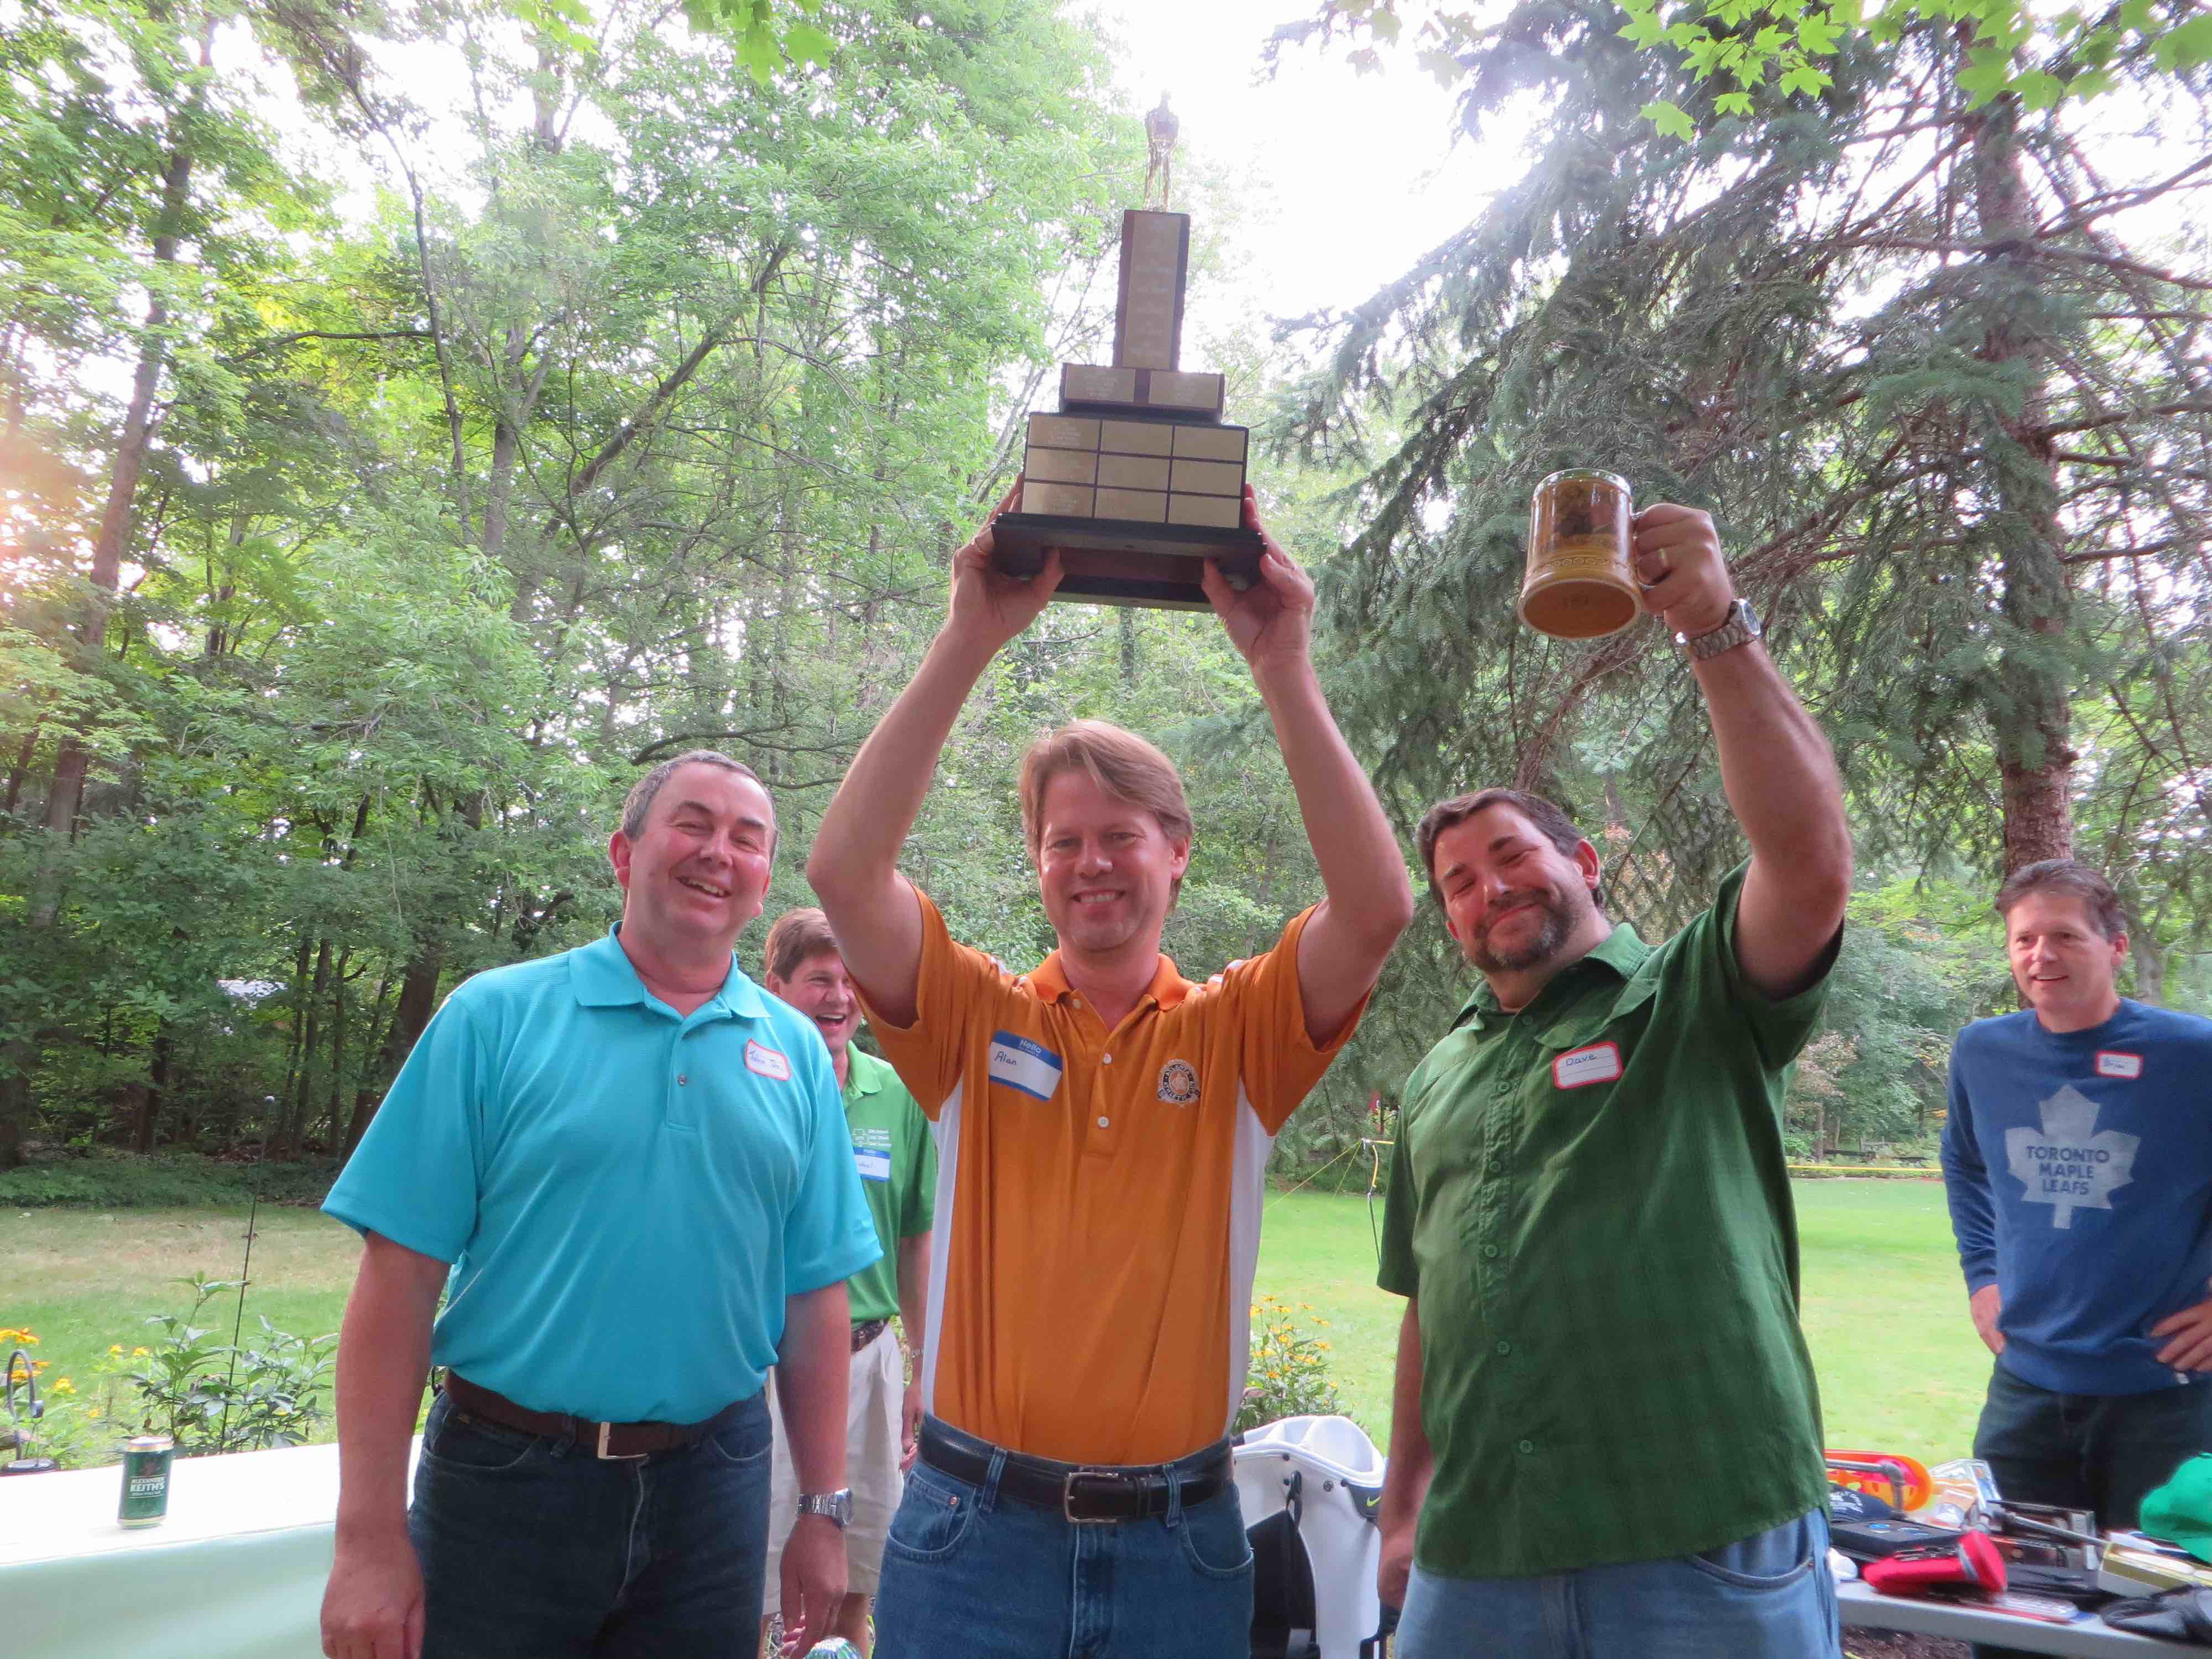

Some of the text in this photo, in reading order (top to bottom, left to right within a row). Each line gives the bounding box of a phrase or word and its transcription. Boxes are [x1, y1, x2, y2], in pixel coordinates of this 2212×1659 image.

[1019, 1039, 1041, 1053] Hello
[994, 1051, 1017, 1066] Alan
[1566, 1053, 1598, 1067] Dave
[2026, 1145, 2110, 1164] TORONTO
[2038, 1162, 2094, 1178] MAPLE
[2042, 1179, 2090, 1195] LEAFS
